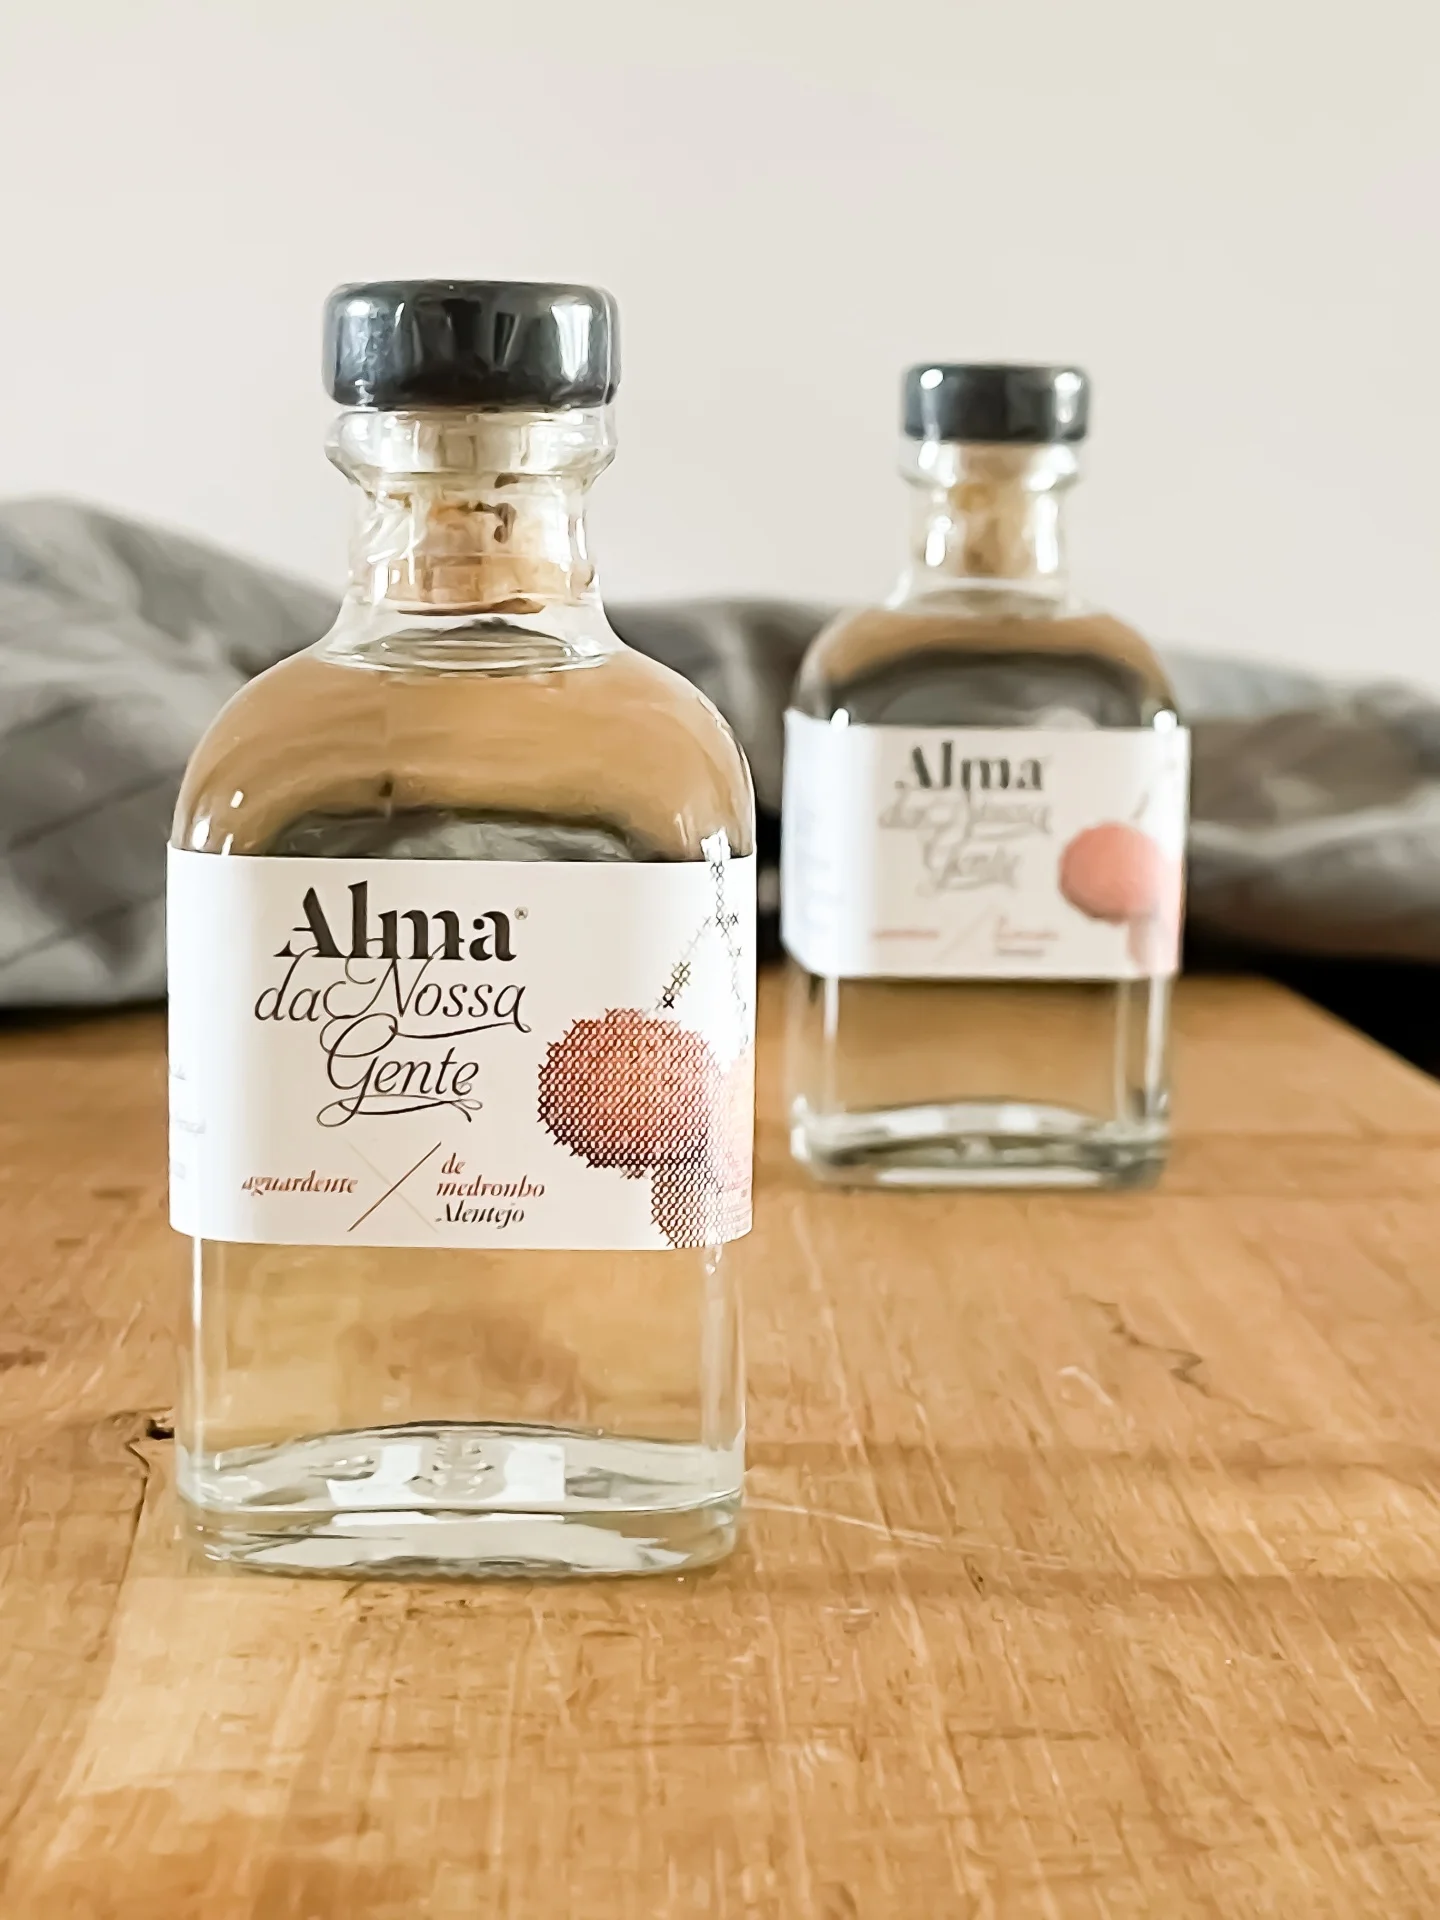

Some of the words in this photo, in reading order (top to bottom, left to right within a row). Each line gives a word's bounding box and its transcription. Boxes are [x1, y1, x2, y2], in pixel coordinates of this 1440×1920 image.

[896, 740, 1043, 793] Alma
[273, 879, 517, 962] Alma
[254, 946, 323, 1022] da
[323, 944, 532, 1040] Nossa
[316, 1012, 483, 1128] Gente
[240, 1169, 359, 1197] aguardente
[440, 1151, 466, 1175] de
[435, 1173, 546, 1199] medronho
[434, 1199, 526, 1230] Alentejo
